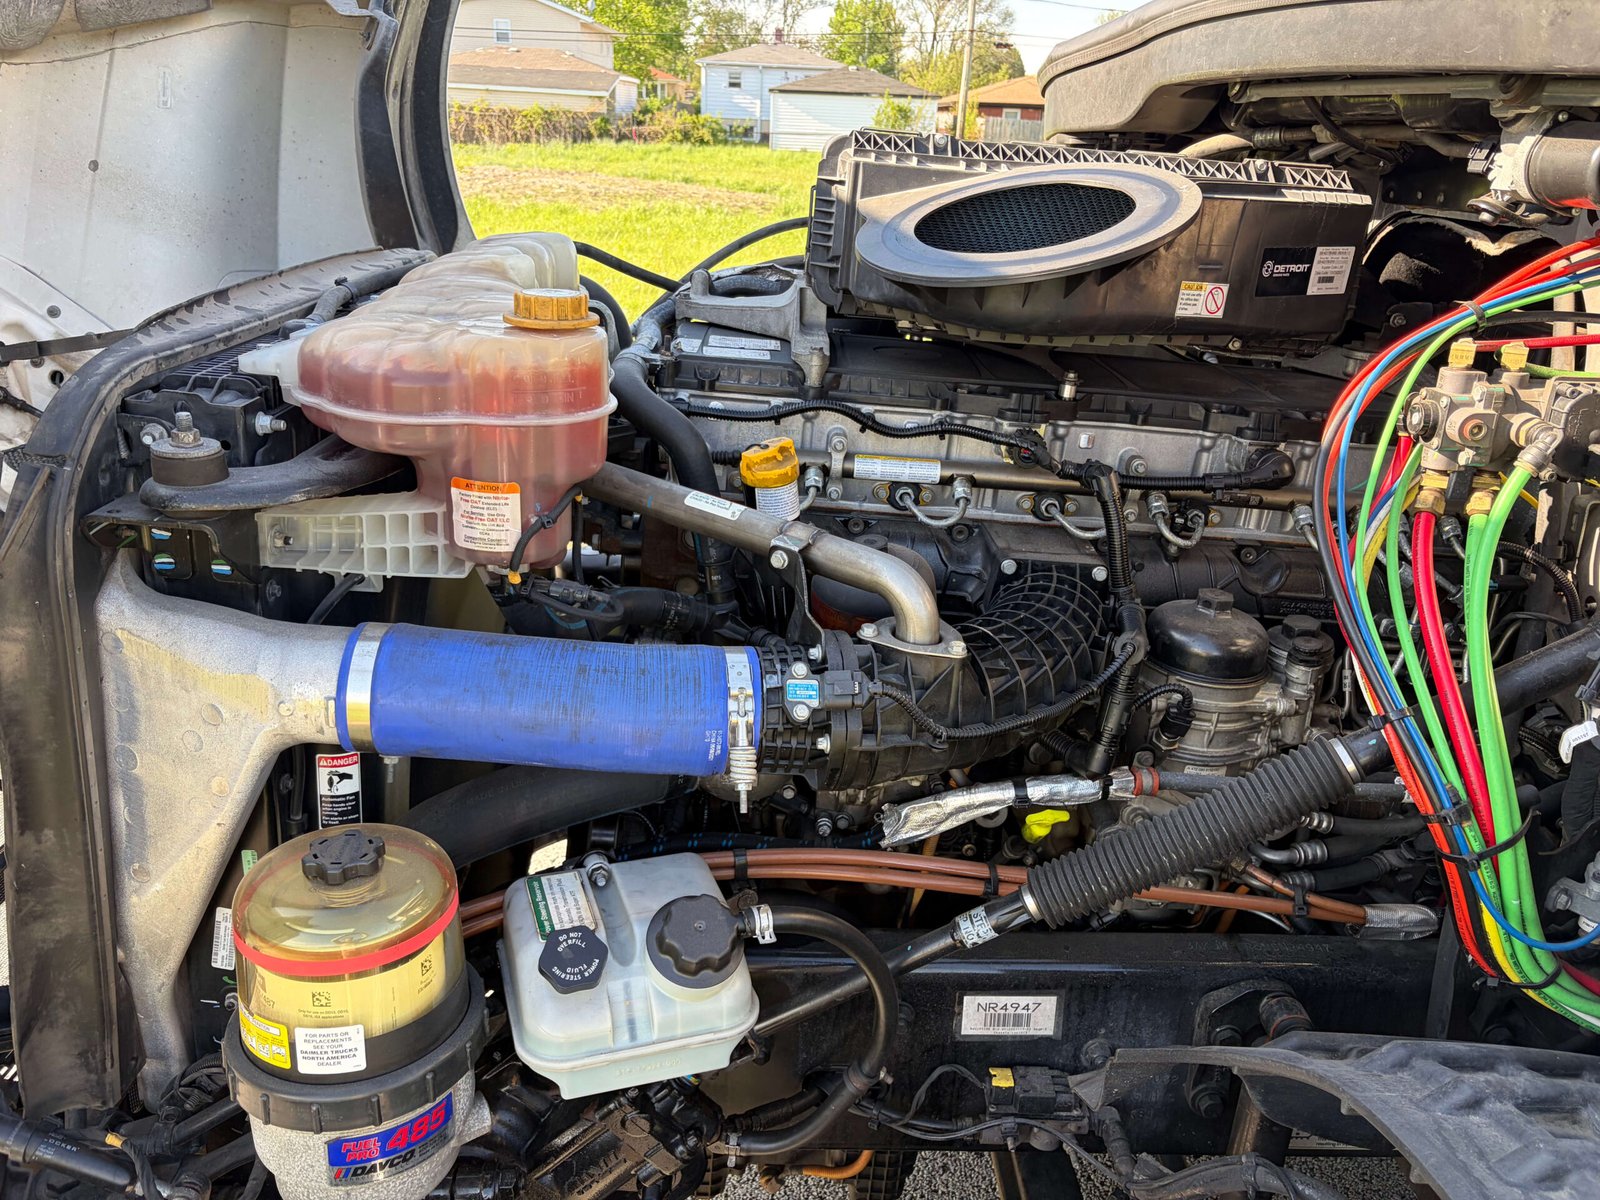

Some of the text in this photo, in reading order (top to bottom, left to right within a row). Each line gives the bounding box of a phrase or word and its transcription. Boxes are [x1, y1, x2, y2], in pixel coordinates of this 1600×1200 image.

[1273, 264, 1311, 272] DETROIT
[465, 482, 502, 492] ATTENTION
[327, 756, 358, 766] DANGER
[533, 881, 543, 902] Reservoir
[539, 902, 548, 920] Steering
[557, 938, 586, 952] OVERFILL
[552, 959, 600, 980] POWER STEERING
[566, 964, 588, 973] FLUID
[977, 1002, 1042, 1013] NR4947
[342, 1137, 381, 1153] FUEL
[386, 1098, 447, 1151] 485
[346, 1147, 380, 1162] PRO
[350, 1149, 416, 1177] DAVCO
